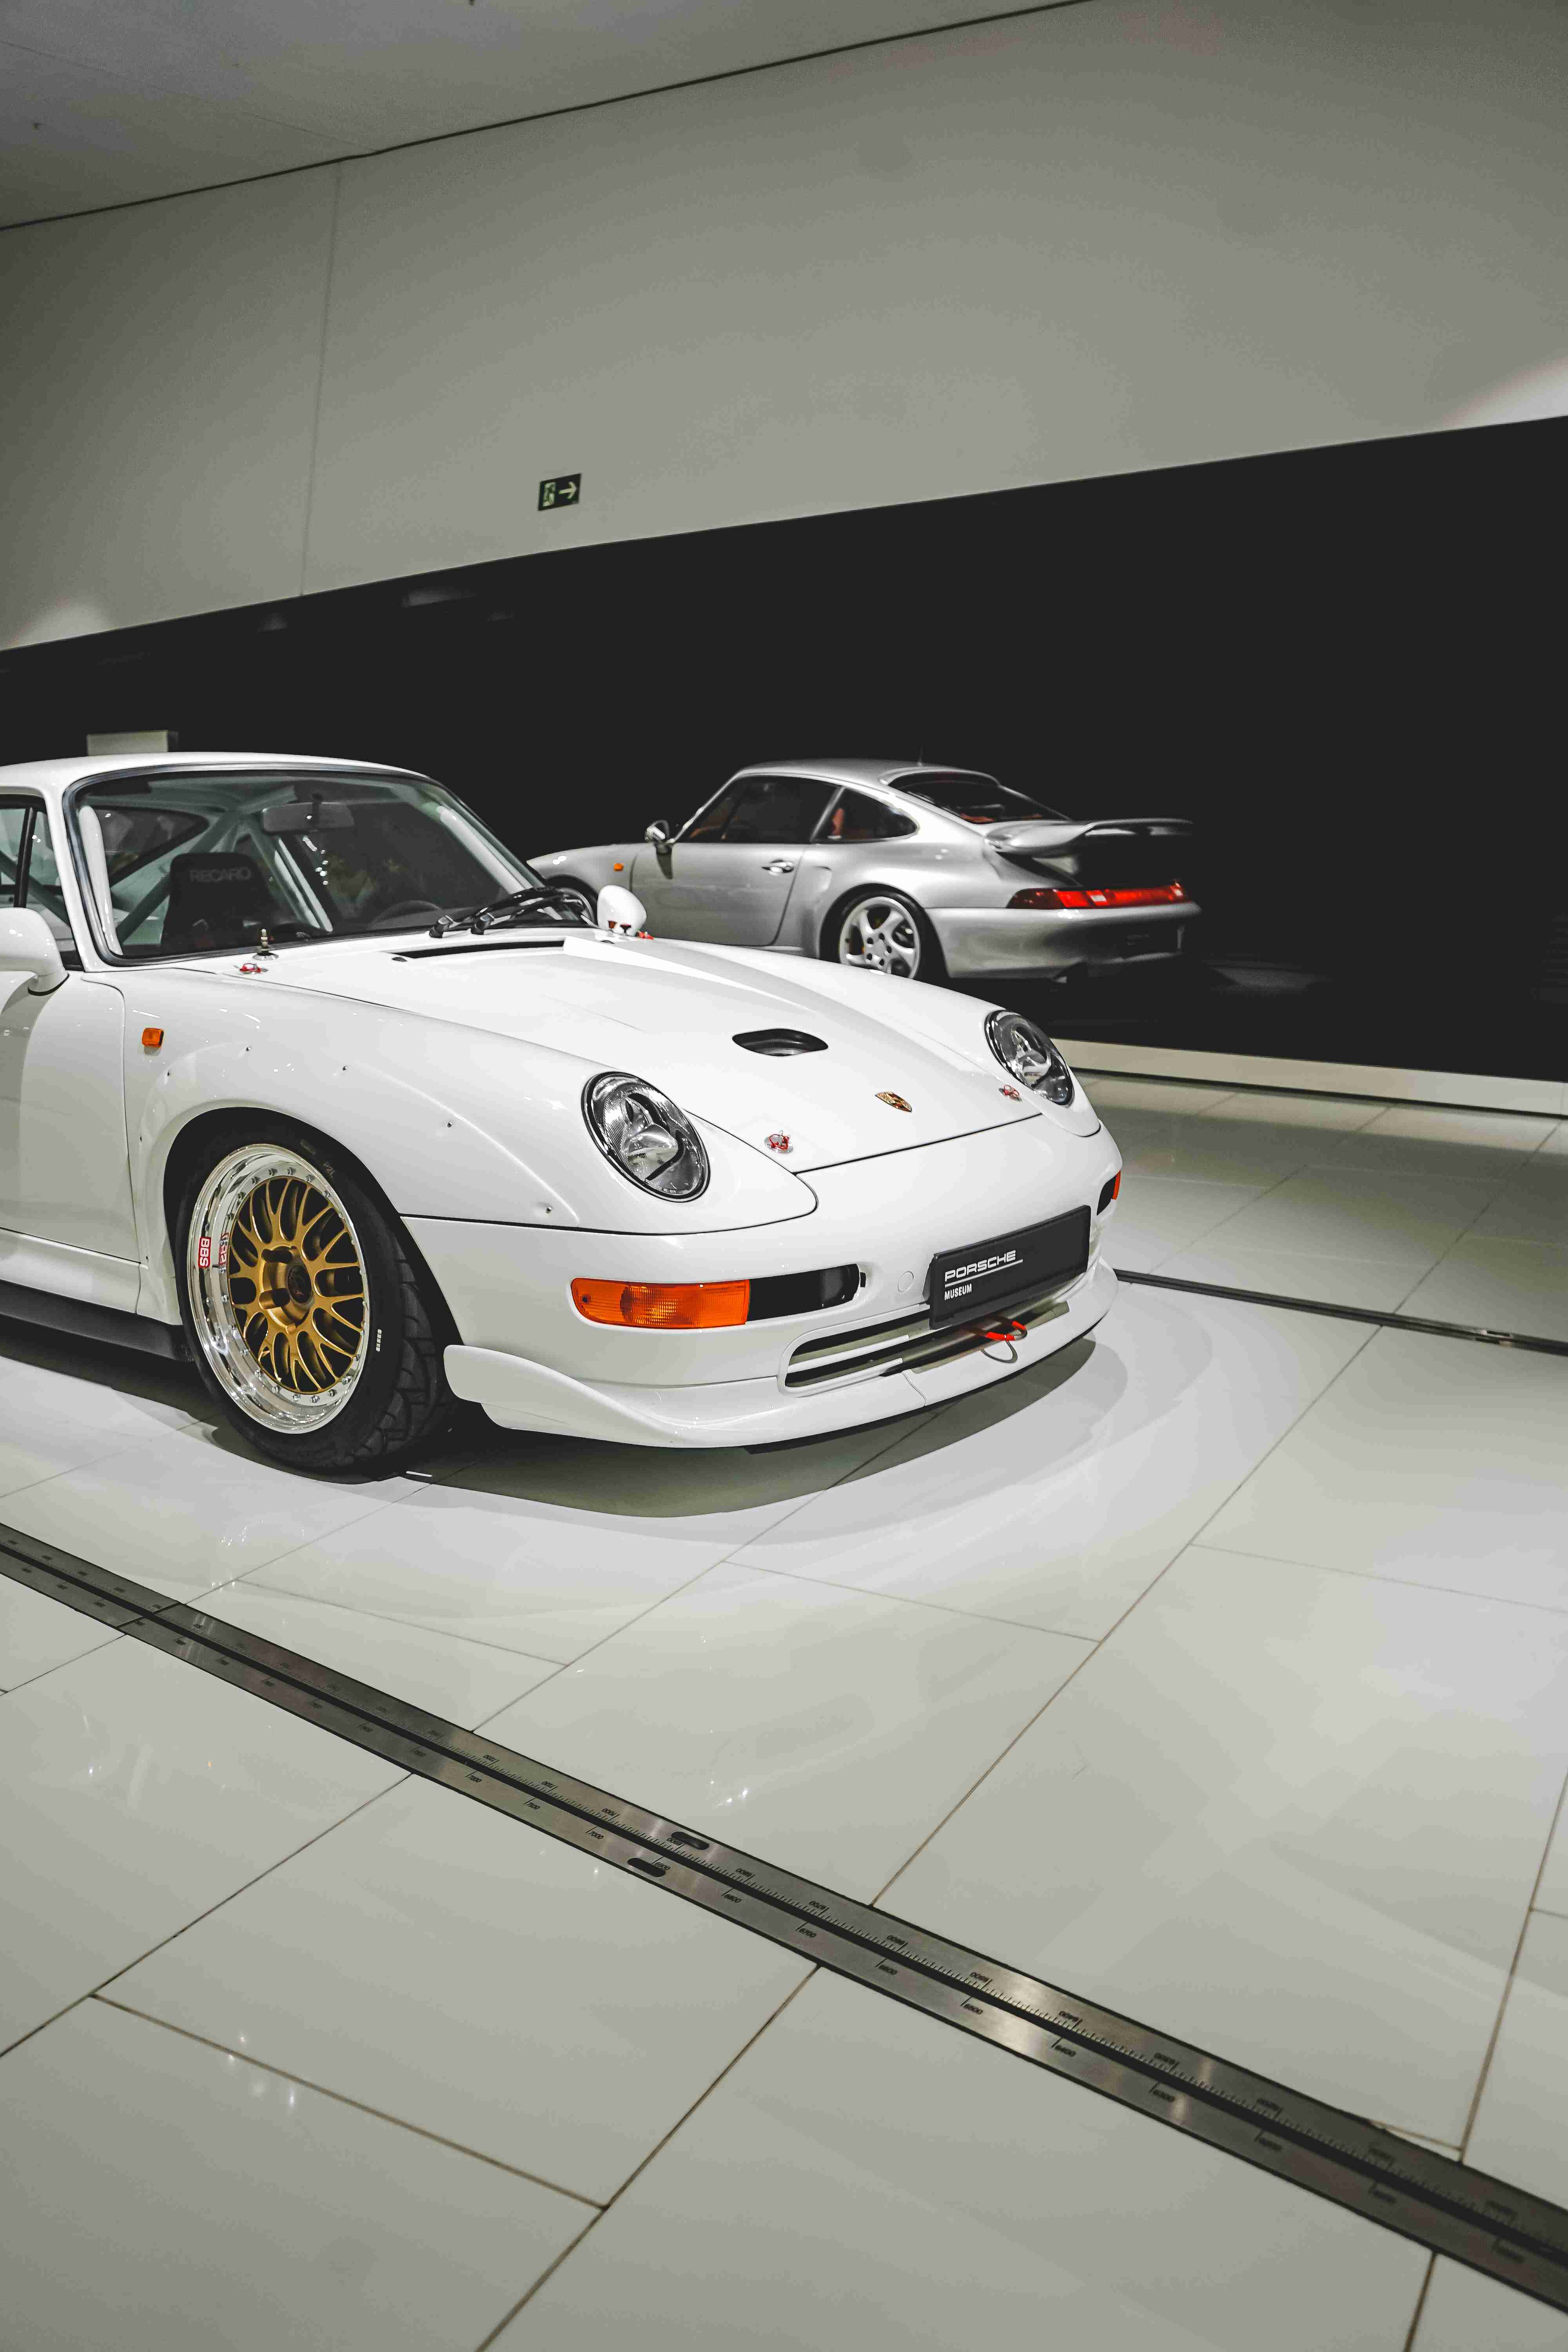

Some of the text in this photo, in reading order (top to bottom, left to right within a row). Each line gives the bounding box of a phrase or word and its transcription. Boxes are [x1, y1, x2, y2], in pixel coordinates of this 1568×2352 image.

[189, 867, 251, 881] RECARO
[200, 1238, 210, 1267] BBS
[944, 1250, 1016, 1282] PORSCHE
[944, 1283, 972, 1301] MUSEUM
[602, 1808, 616, 1817] 7000
[590, 1831, 604, 1839] 7000
[800, 1927, 817, 1938] 6700
